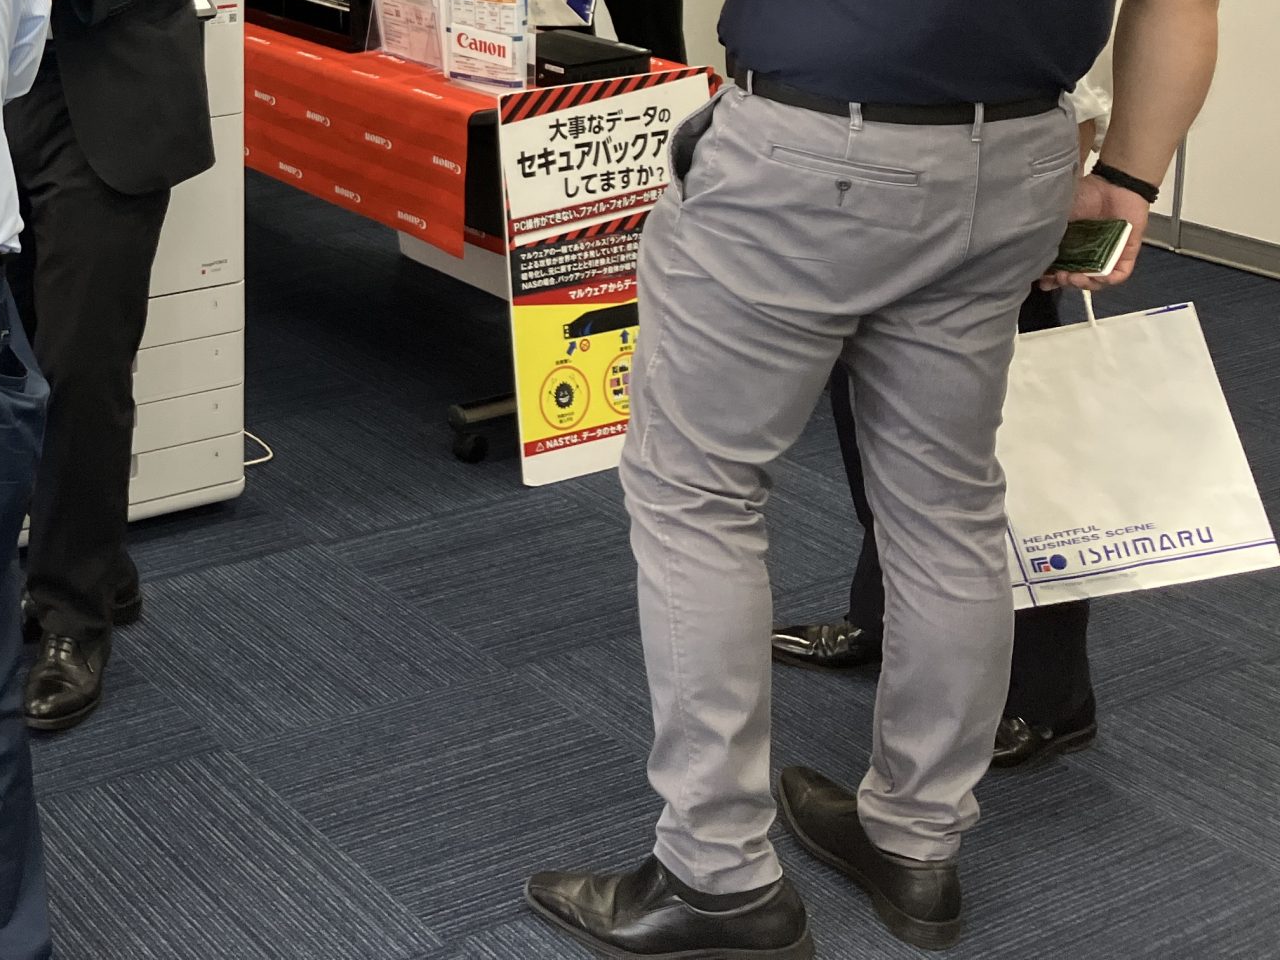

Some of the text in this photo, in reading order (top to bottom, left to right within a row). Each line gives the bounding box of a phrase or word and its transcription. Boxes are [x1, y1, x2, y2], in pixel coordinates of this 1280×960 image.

[456, 32, 507, 59] Canon
[548, 105, 671, 142] 大事なデータの
[364, 131, 393, 150] Canon
[516, 129, 669, 178] セキュアバックア
[334, 185, 361, 204] Canon
[564, 164, 665, 198] してますか？
[397, 209, 427, 230] Canon
[513, 188, 665, 232] PC操作ができない、ファイル・フォルダーが使え
[520, 242, 639, 271] による攻撃が世界中で多発しています。感染
[521, 262, 637, 290] NASの場合、バックアップデータ自体が暗号
[568, 279, 637, 300] マルウェアからデー
[546, 424, 628, 449] NASでは、データのセキュ
[1023, 525, 1101, 545] HEARTFUL
[1025, 522, 1157, 553] BUSINESS SCENE
[1078, 526, 1215, 566] ISHIMARU
